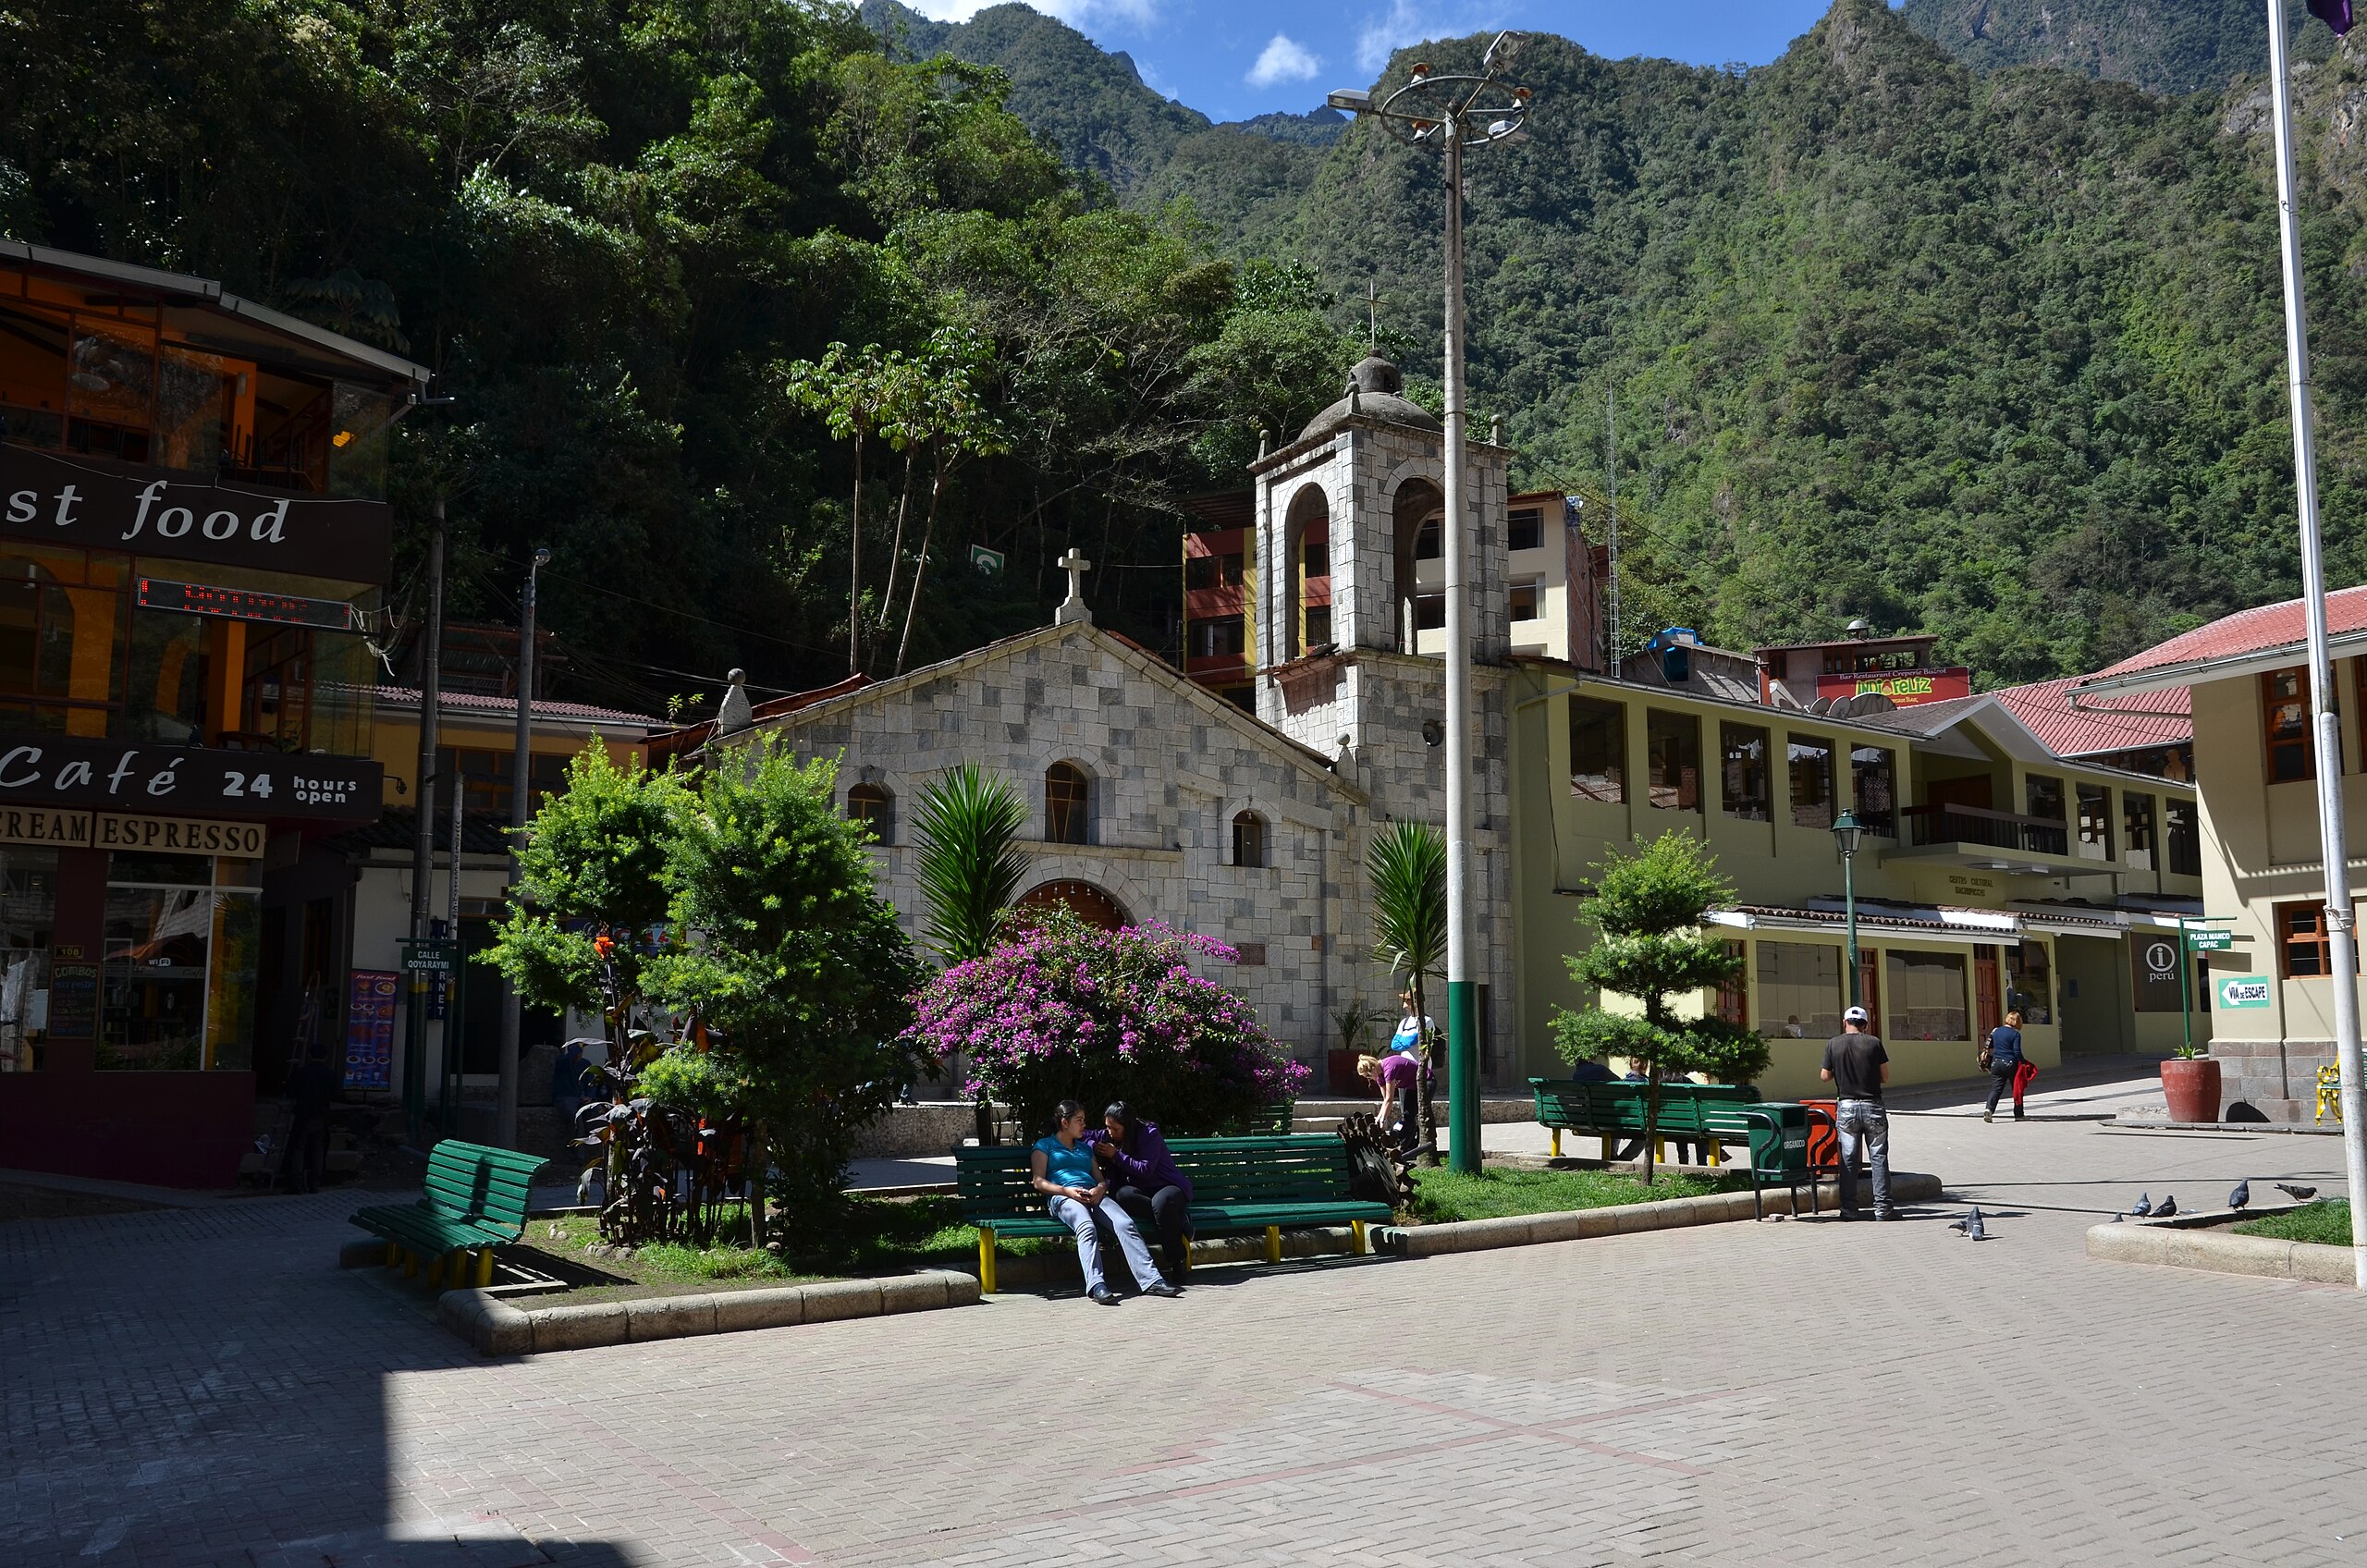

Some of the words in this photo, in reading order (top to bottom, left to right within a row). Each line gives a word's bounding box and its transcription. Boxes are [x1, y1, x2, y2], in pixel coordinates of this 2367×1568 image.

[121, 480, 291, 544] food
[1853, 671, 1891, 680] Restaurant
[0, 745, 185, 796] Café
[222, 771, 274, 800] 24
[292, 776, 358, 793] hours
[296, 789, 347, 806] open
[0, 810, 88, 841] REAM
[102, 816, 260, 853] ESPRESSO
[2209, 932, 2231, 940] MANCO
[2199, 940, 2219, 949] CAPAC
[418, 950, 440, 960] CALLE
[408, 960, 449, 970] QOYARAYMI
[2149, 970, 2175, 983] perú
[2228, 986, 2239, 999] VIA
[2245, 986, 2266, 999] ESCAPE
[1784, 1139, 1805, 1149] ORGANICO
